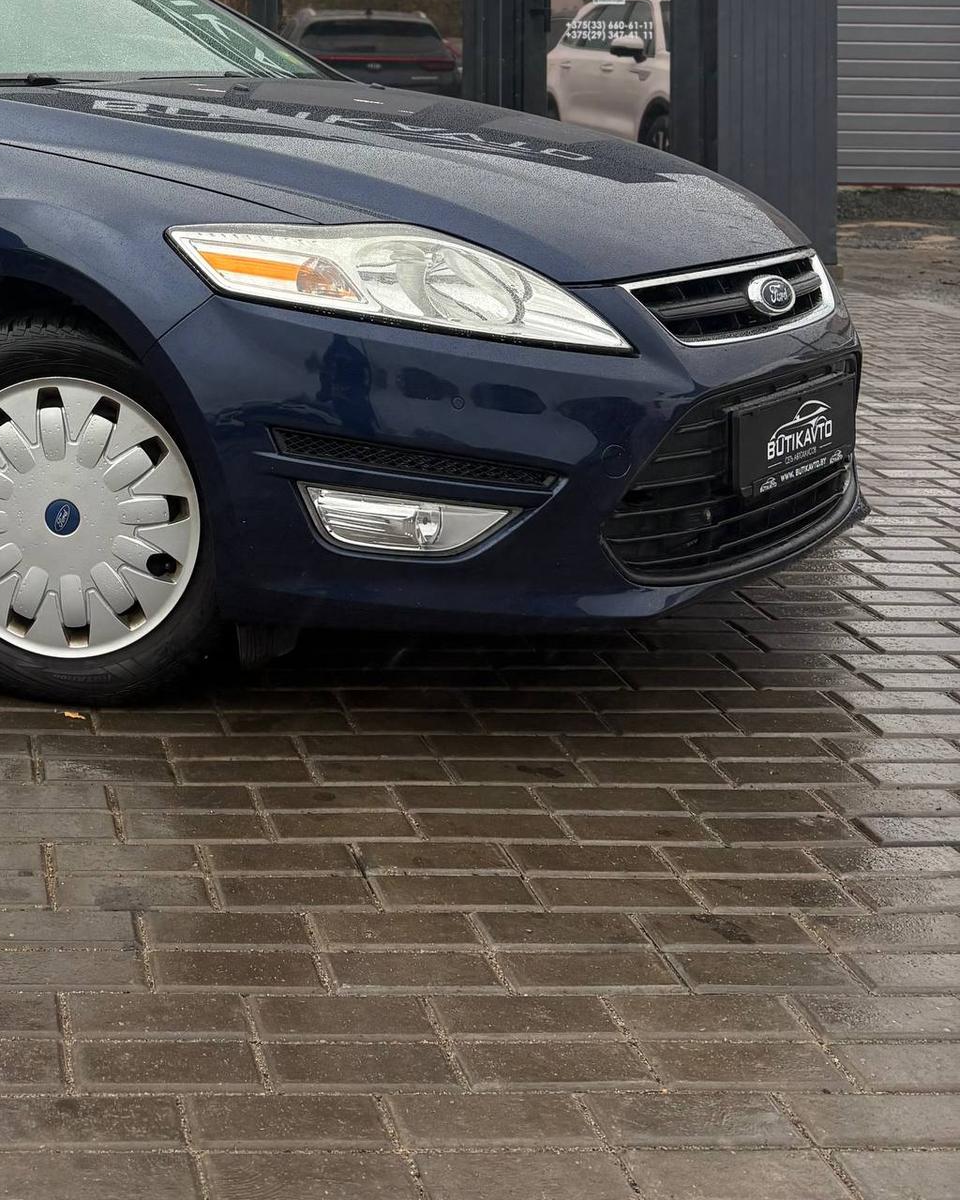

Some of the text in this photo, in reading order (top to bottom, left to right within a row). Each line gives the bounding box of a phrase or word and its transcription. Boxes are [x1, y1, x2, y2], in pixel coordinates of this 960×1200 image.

[565, 21, 653, 32] +375(33) 660-61-11
[767, 419, 833, 460] BUTIKAVTO
